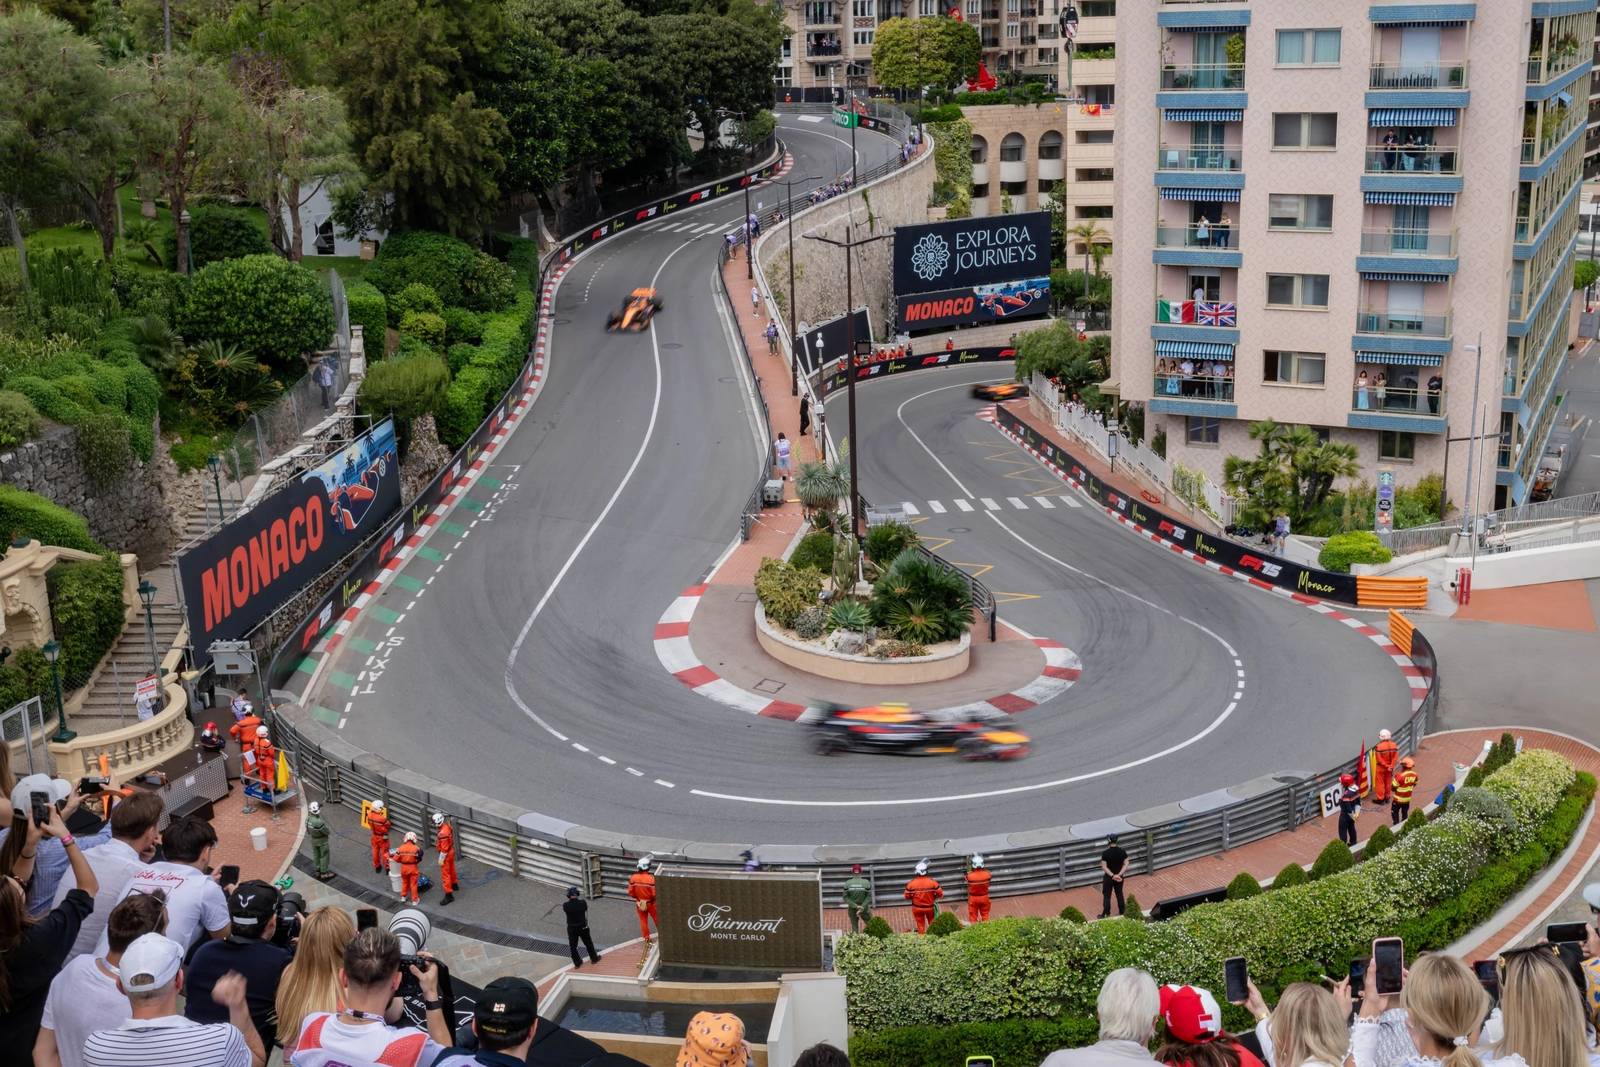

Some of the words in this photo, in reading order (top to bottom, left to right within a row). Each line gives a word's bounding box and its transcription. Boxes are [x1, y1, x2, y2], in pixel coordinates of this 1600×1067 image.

[956, 226, 1031, 250] EXPLORA
[954, 244, 1036, 275] JOURNEYS
[906, 296, 974, 322] MONACO
[202, 495, 323, 633] MONACO
[1298, 570, 1335, 594] Monaco
[360, 636, 405, 694] TAXIS
[1325, 789, 1339, 811] SC
[688, 903, 786, 933] Fairmont
[710, 932, 737, 940] MONTE
